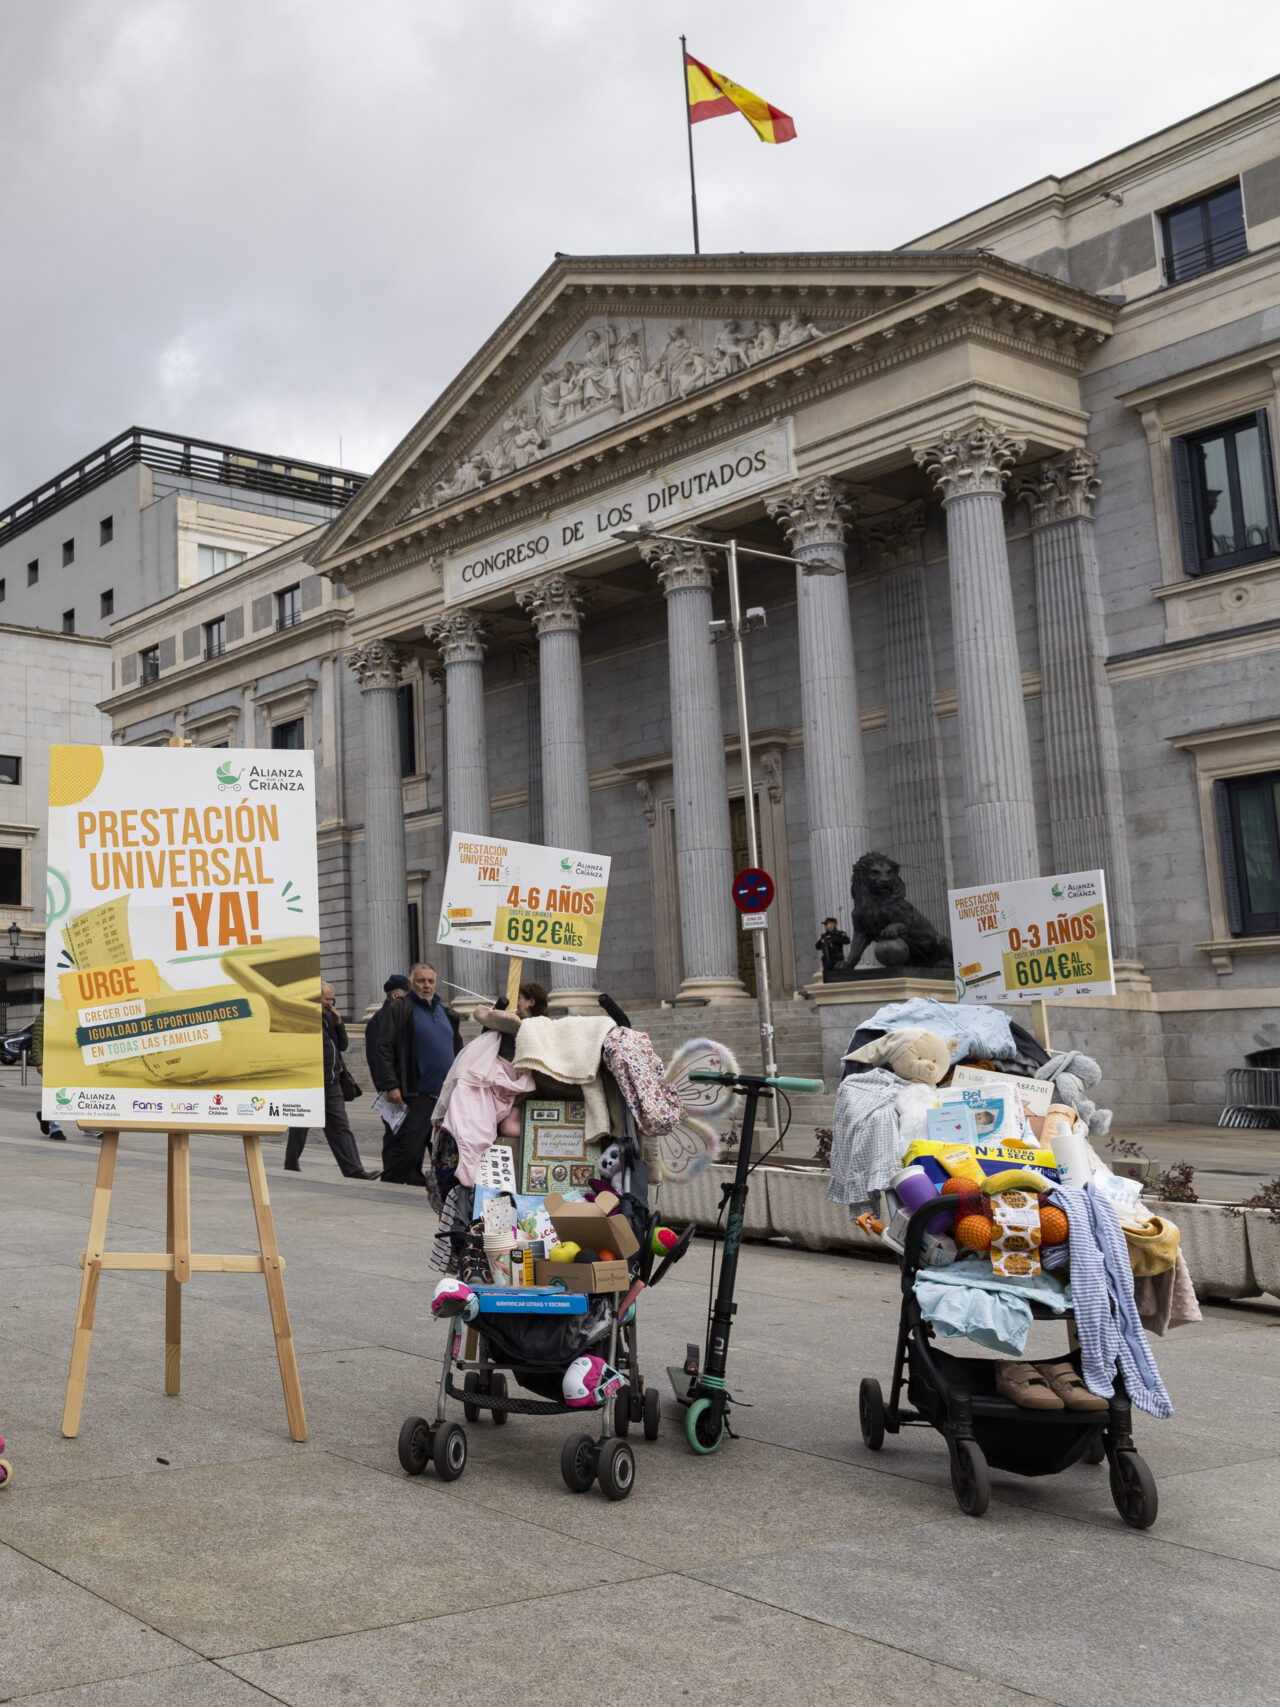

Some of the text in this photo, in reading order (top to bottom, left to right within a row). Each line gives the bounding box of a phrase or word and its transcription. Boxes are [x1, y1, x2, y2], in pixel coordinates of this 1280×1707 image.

[461, 450, 768, 583] CONGRESO DE LOS DIPUTADOS
[249, 766, 303, 778] ALIANZA
[249, 779, 305, 791] CRIANZA
[77, 797, 279, 849] PRESTACIÓN
[458, 842, 508, 857] PRESTACIÓN
[460, 853, 504, 867] UNIVERSAL
[577, 861, 603, 871] ALIANZA
[89, 847, 274, 890] UNIVERSAL
[478, 866, 500, 881] ¡YA!
[575, 868, 603, 878] CRIANZA
[507, 885, 595, 916] 4-6 AÑOS
[955, 890, 1000, 909] PRESTACIÓN
[1067, 890, 1096, 898] CRIANZA
[959, 903, 999, 920] UNIVERSAL
[172, 891, 263, 951] ¡YA!
[977, 914, 998, 932] ¡YA!
[507, 917, 563, 945] 692€
[564, 922, 575, 934] AL
[1008, 913, 1096, 952] 0-3 AÑOS
[563, 934, 583, 947] MES
[1015, 953, 1072, 986] 604€
[1071, 952, 1083, 964] AL
[1072, 962, 1093, 977] MES
[78, 966, 139, 1001] URGE
[85, 1004, 142, 1022] CRECER CON
[88, 1006, 239, 1041] IGUALDAD DE OPORTUNIDADES
[91, 1029, 210, 1058] EN TODAS LAS FAMILIAS
[79, 1091, 115, 1100] ALIANZA
[962, 1090, 981, 1101] Bel
[78, 1101, 116, 1110] CRIANZA
[171, 1102, 199, 1111] unaf
[969, 1100, 987, 1108] baby
[944, 1151, 968, 1160] WELEDA
